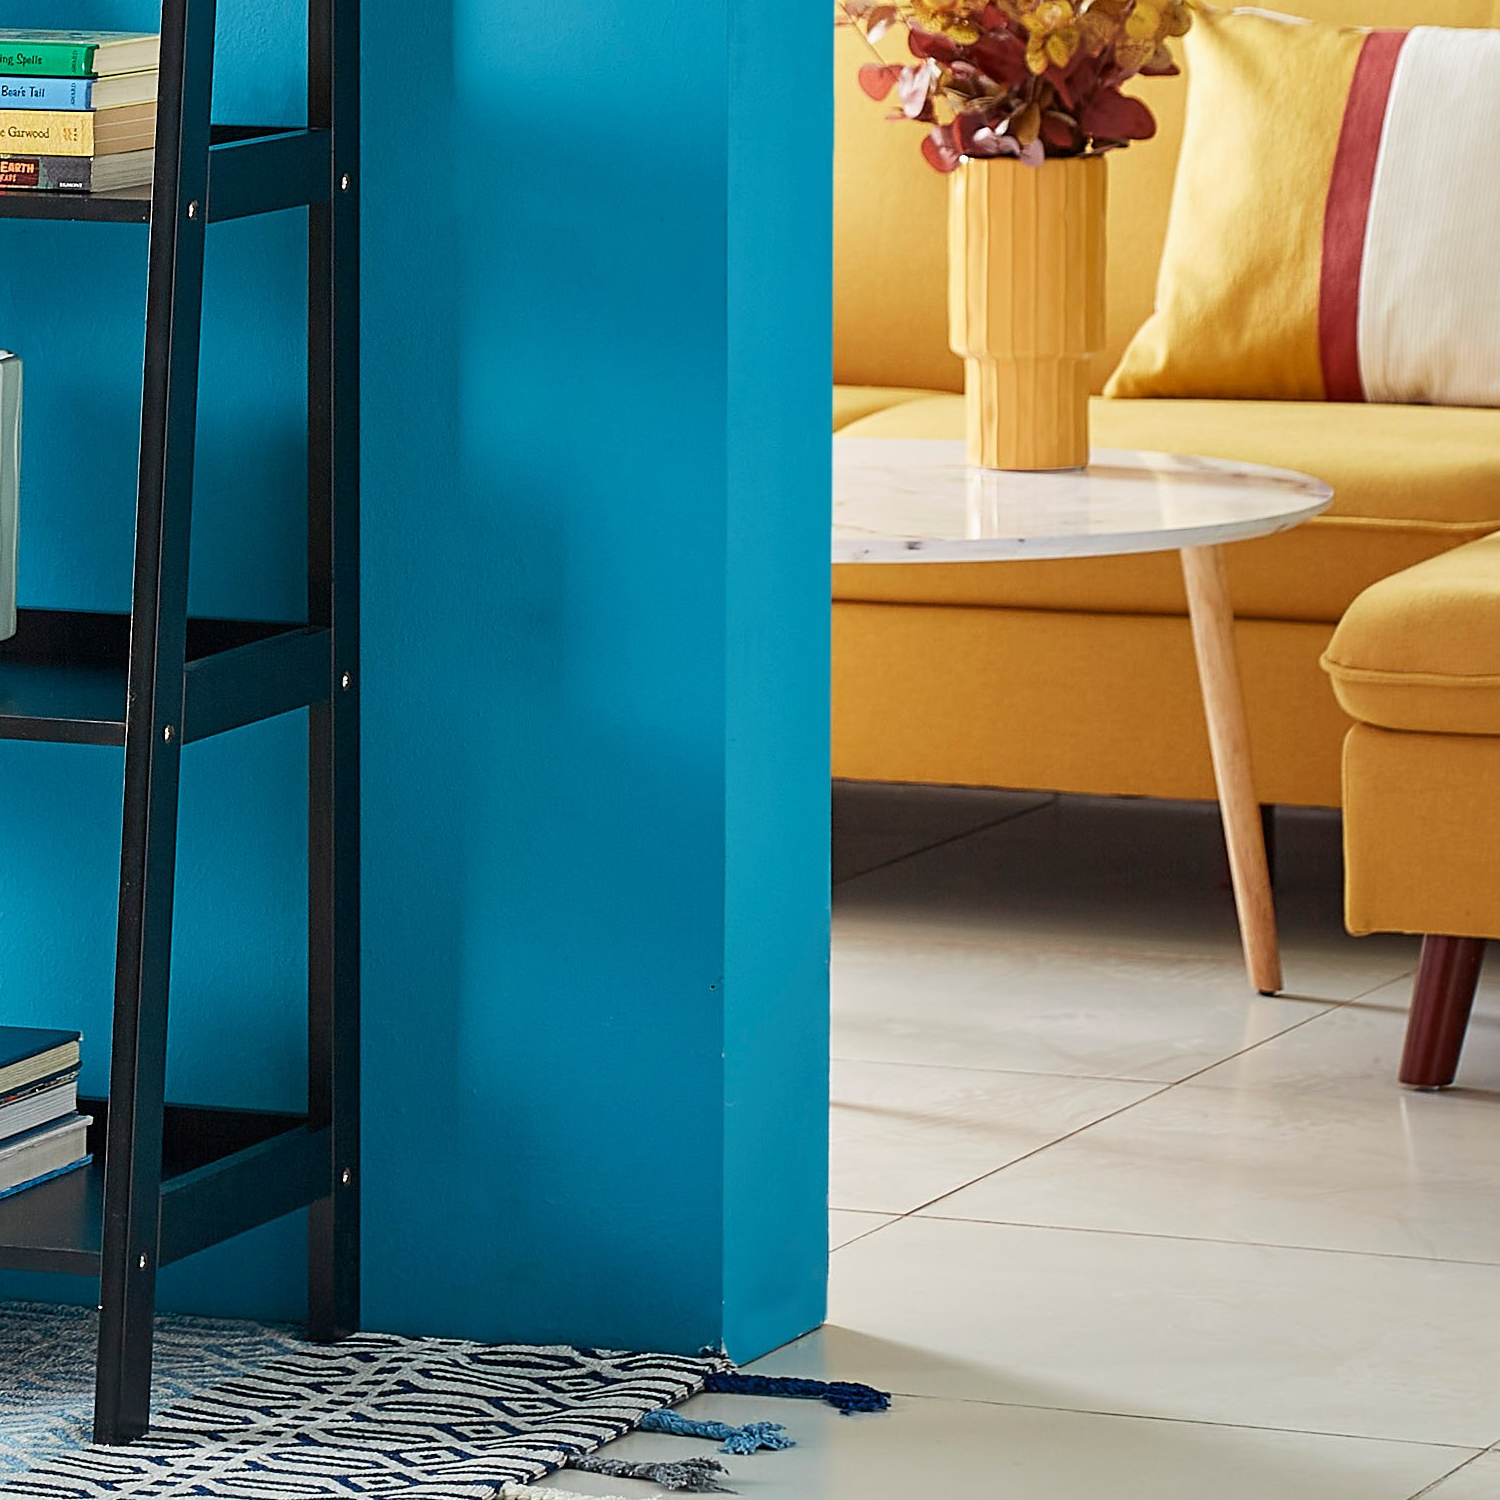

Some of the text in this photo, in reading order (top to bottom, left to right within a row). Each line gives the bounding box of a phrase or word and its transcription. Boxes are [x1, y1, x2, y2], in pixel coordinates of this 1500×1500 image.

[16, 53, 43, 67] Spells
[1, 85, 26, 97] Bear's
[29, 86, 45, 98] Tail
[8, 126, 50, 139] Garwood
[0, 161, 35, 174] EARTH
